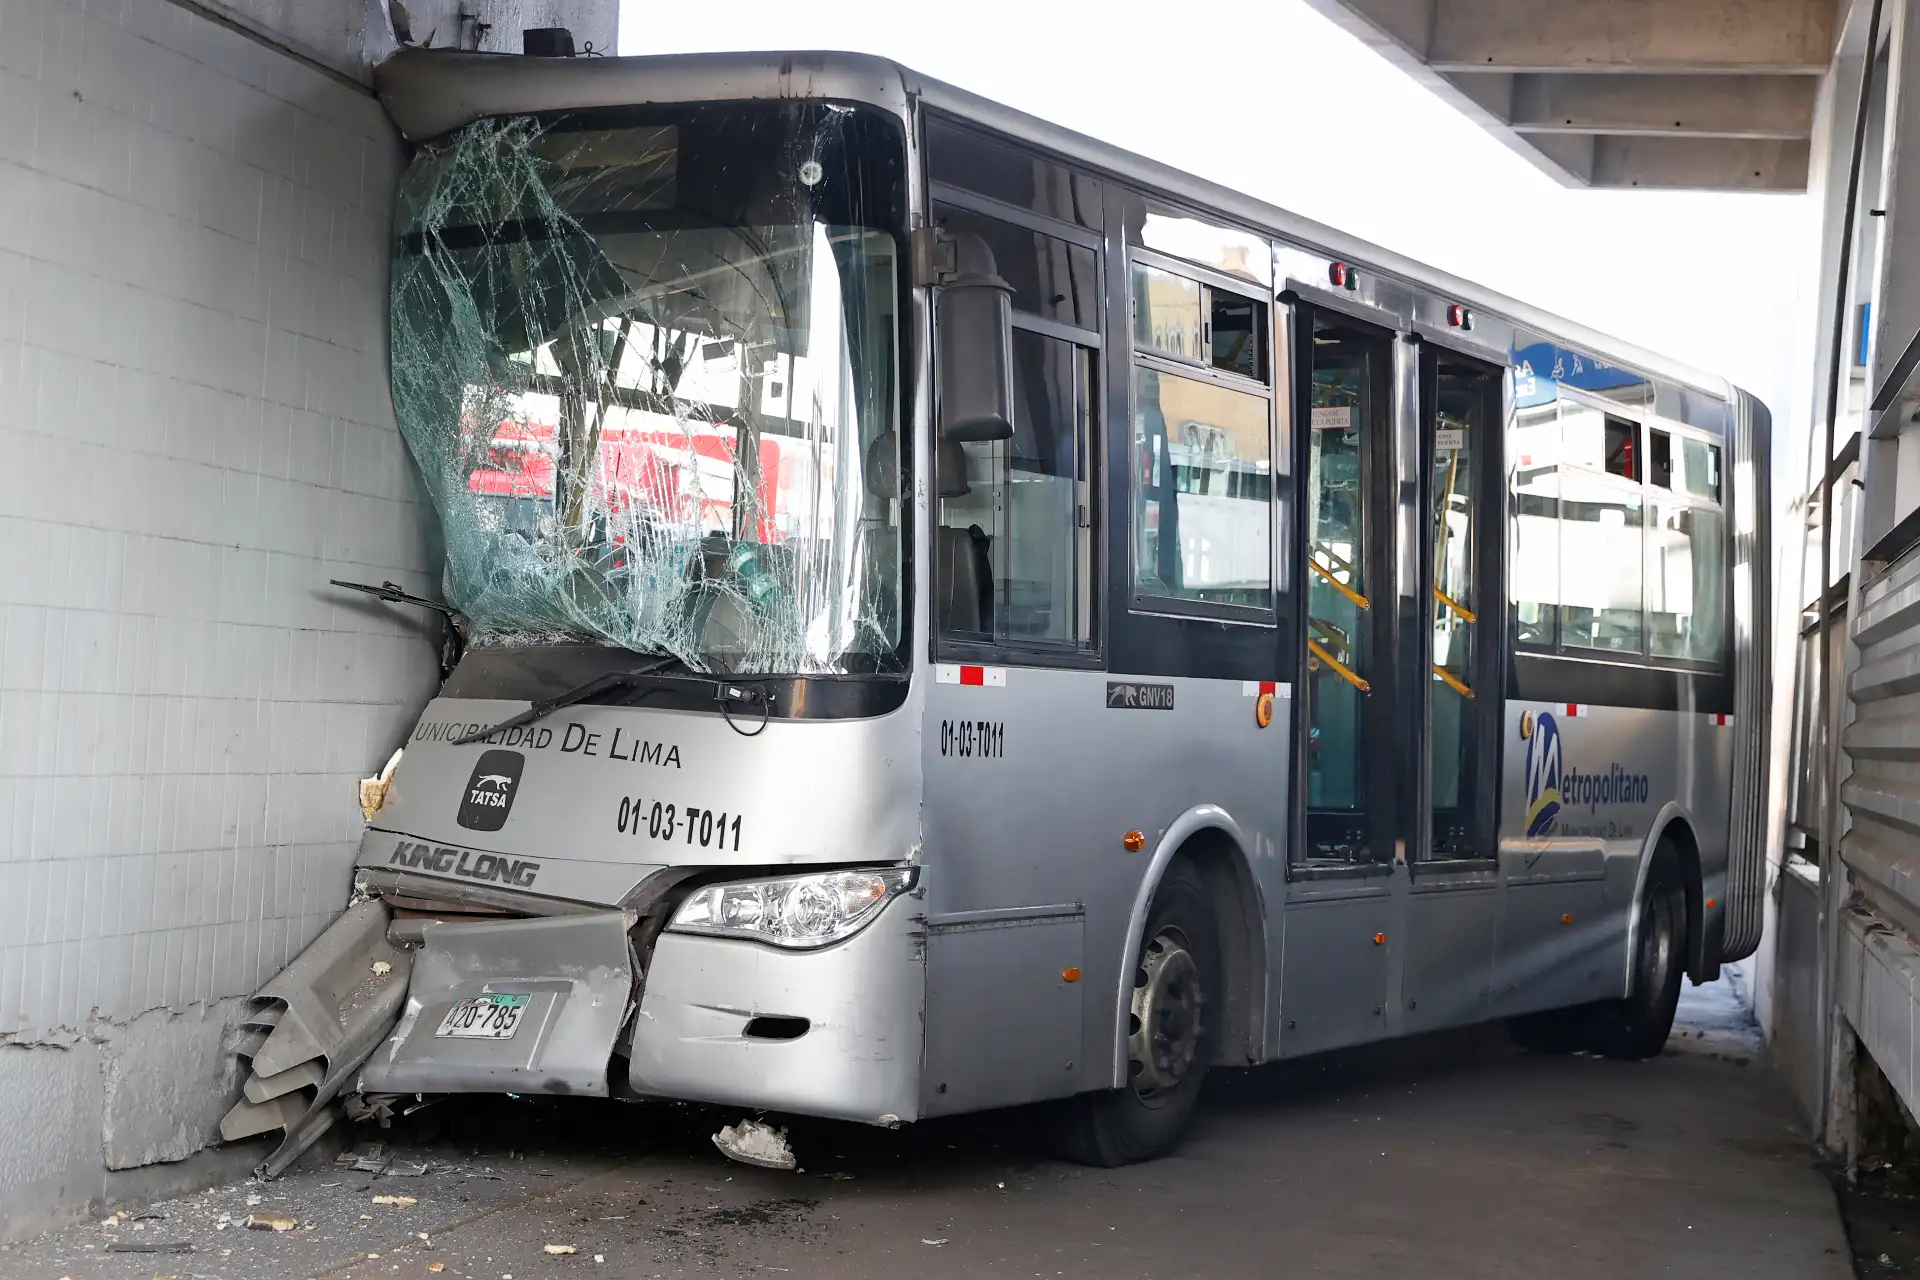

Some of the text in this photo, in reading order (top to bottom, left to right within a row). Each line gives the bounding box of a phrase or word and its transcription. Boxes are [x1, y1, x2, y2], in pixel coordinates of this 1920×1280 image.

[1139, 686, 1173, 708] GNV18
[415, 722, 553, 749] UNICIPALIDAD
[941, 719, 1004, 758] 01-03-T011
[470, 789, 507, 808] TATSA
[618, 796, 742, 852] 01-03-T011
